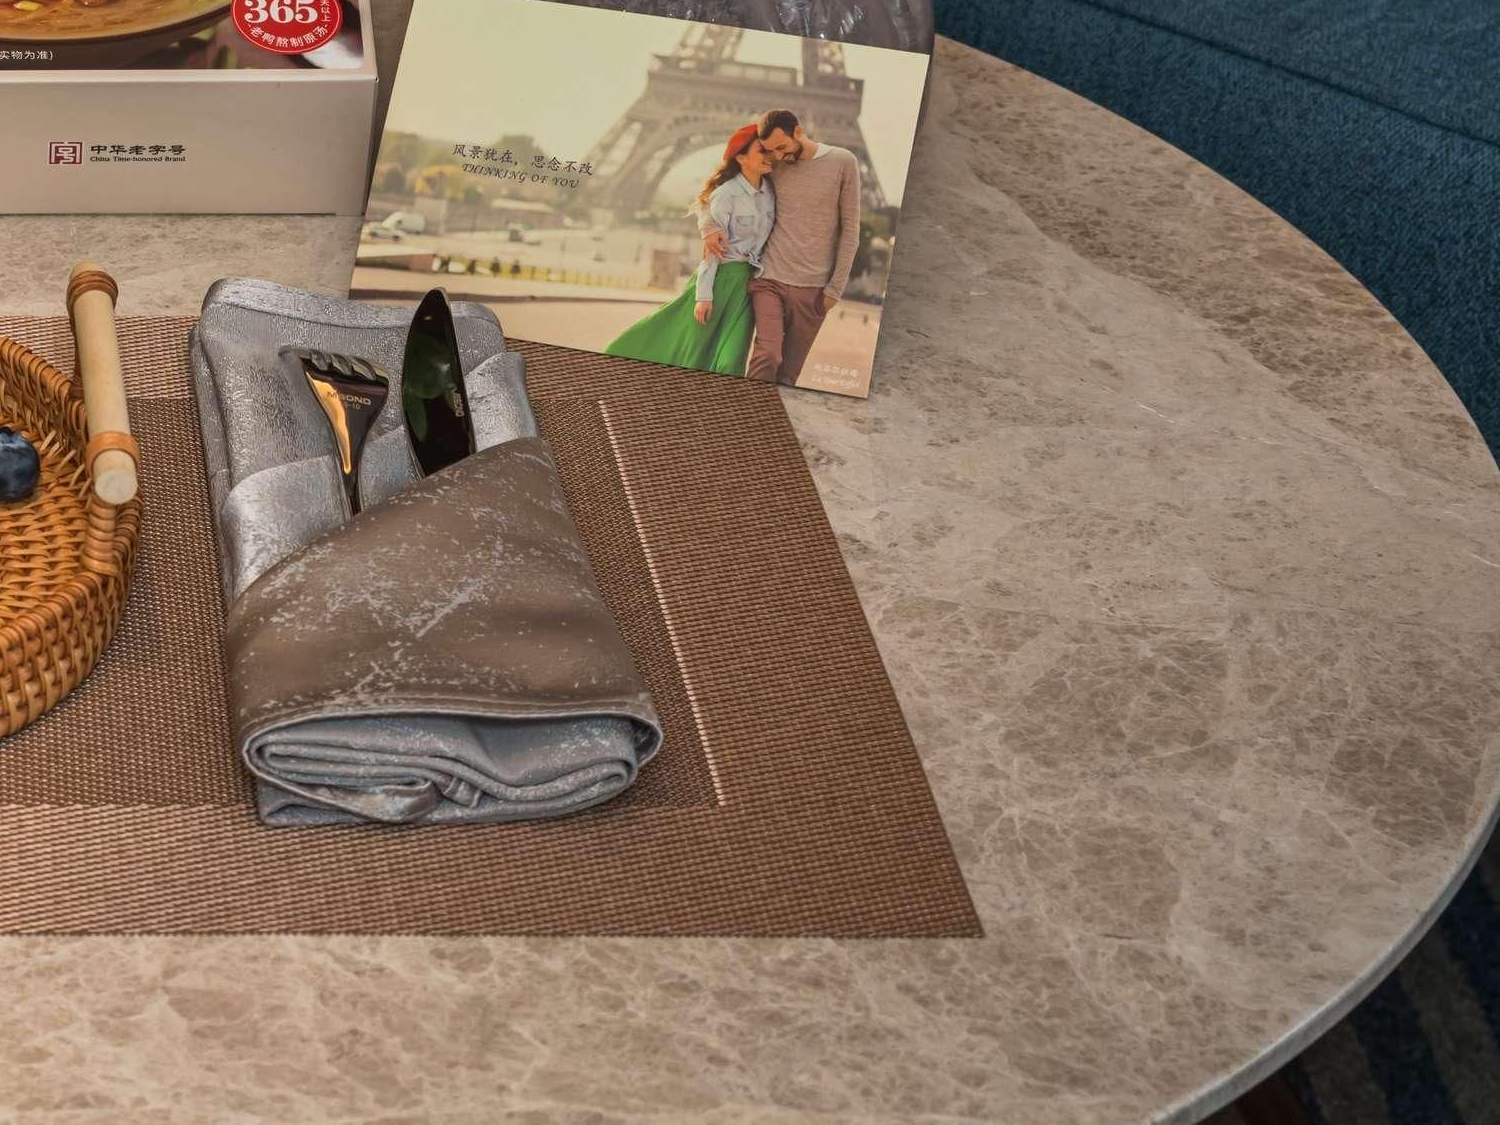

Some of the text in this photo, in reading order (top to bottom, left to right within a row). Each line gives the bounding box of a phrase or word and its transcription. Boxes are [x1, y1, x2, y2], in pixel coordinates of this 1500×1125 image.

[90, 144, 186, 155] 中华老字号
[461, 163, 580, 189] THINKING OF YOU
